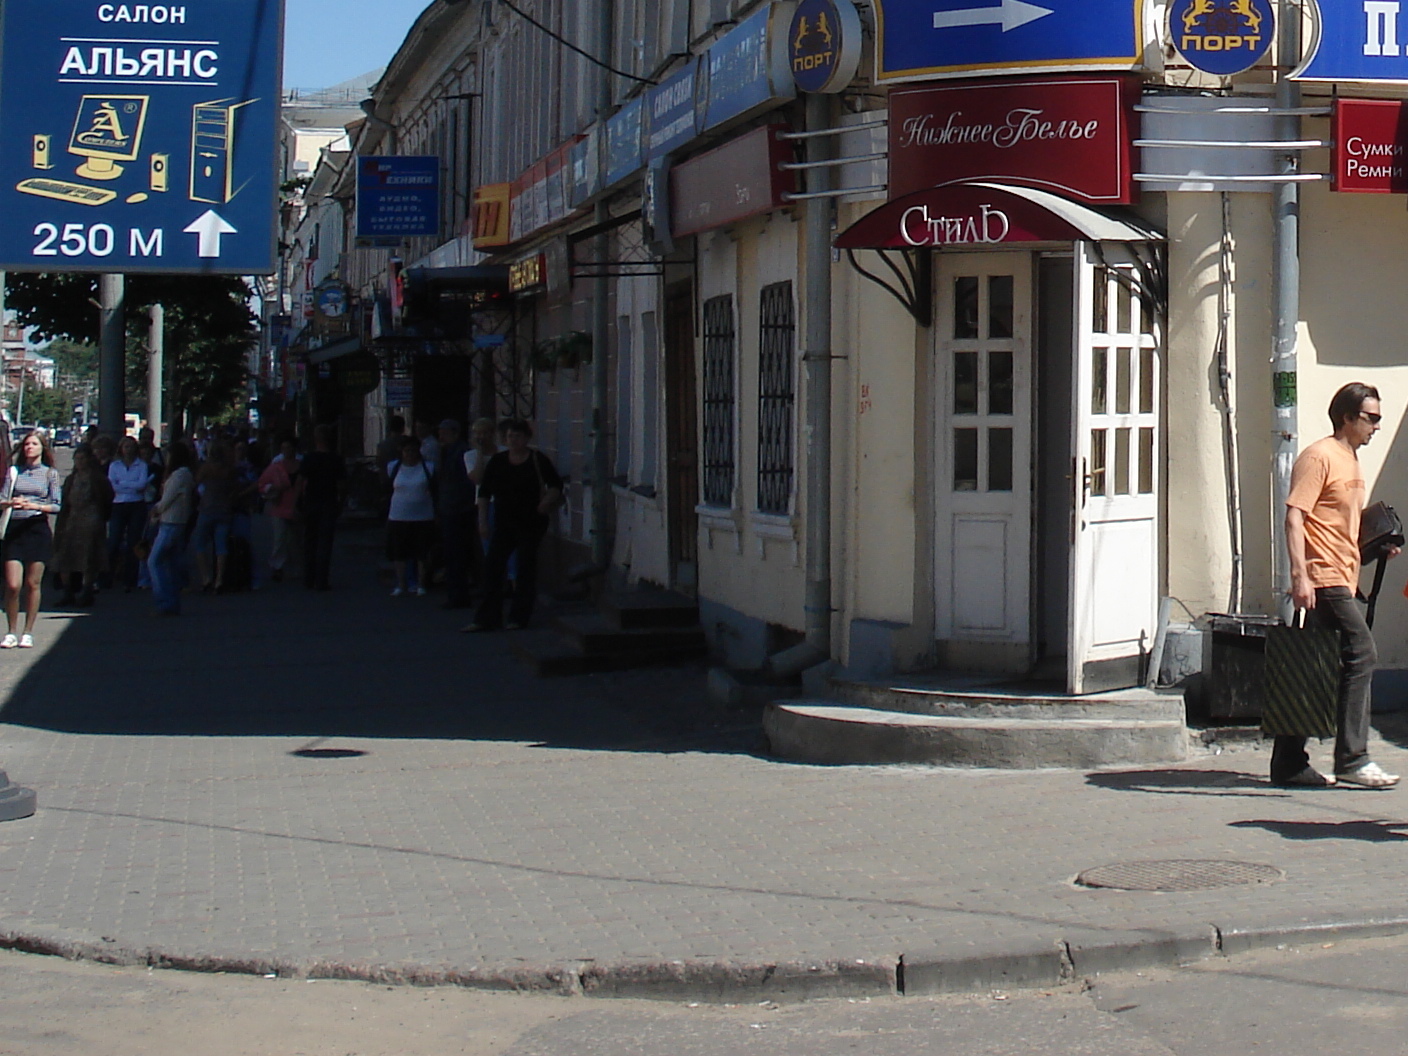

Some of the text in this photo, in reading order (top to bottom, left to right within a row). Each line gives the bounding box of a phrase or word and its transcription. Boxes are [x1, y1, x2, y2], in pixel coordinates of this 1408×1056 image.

[98, 4, 186, 24] САЛОН
[1182, 35, 1261, 51] ПОРТ
[59, 47, 219, 78] АЛЬЯНС
[793, 51, 832, 72] ПОРТ
[900, 108, 1098, 148] Нижнее Белье
[1346, 137, 1403, 160] Сумки
[1347, 159, 1402, 178] Ремни
[32, 223, 114, 257] 250
